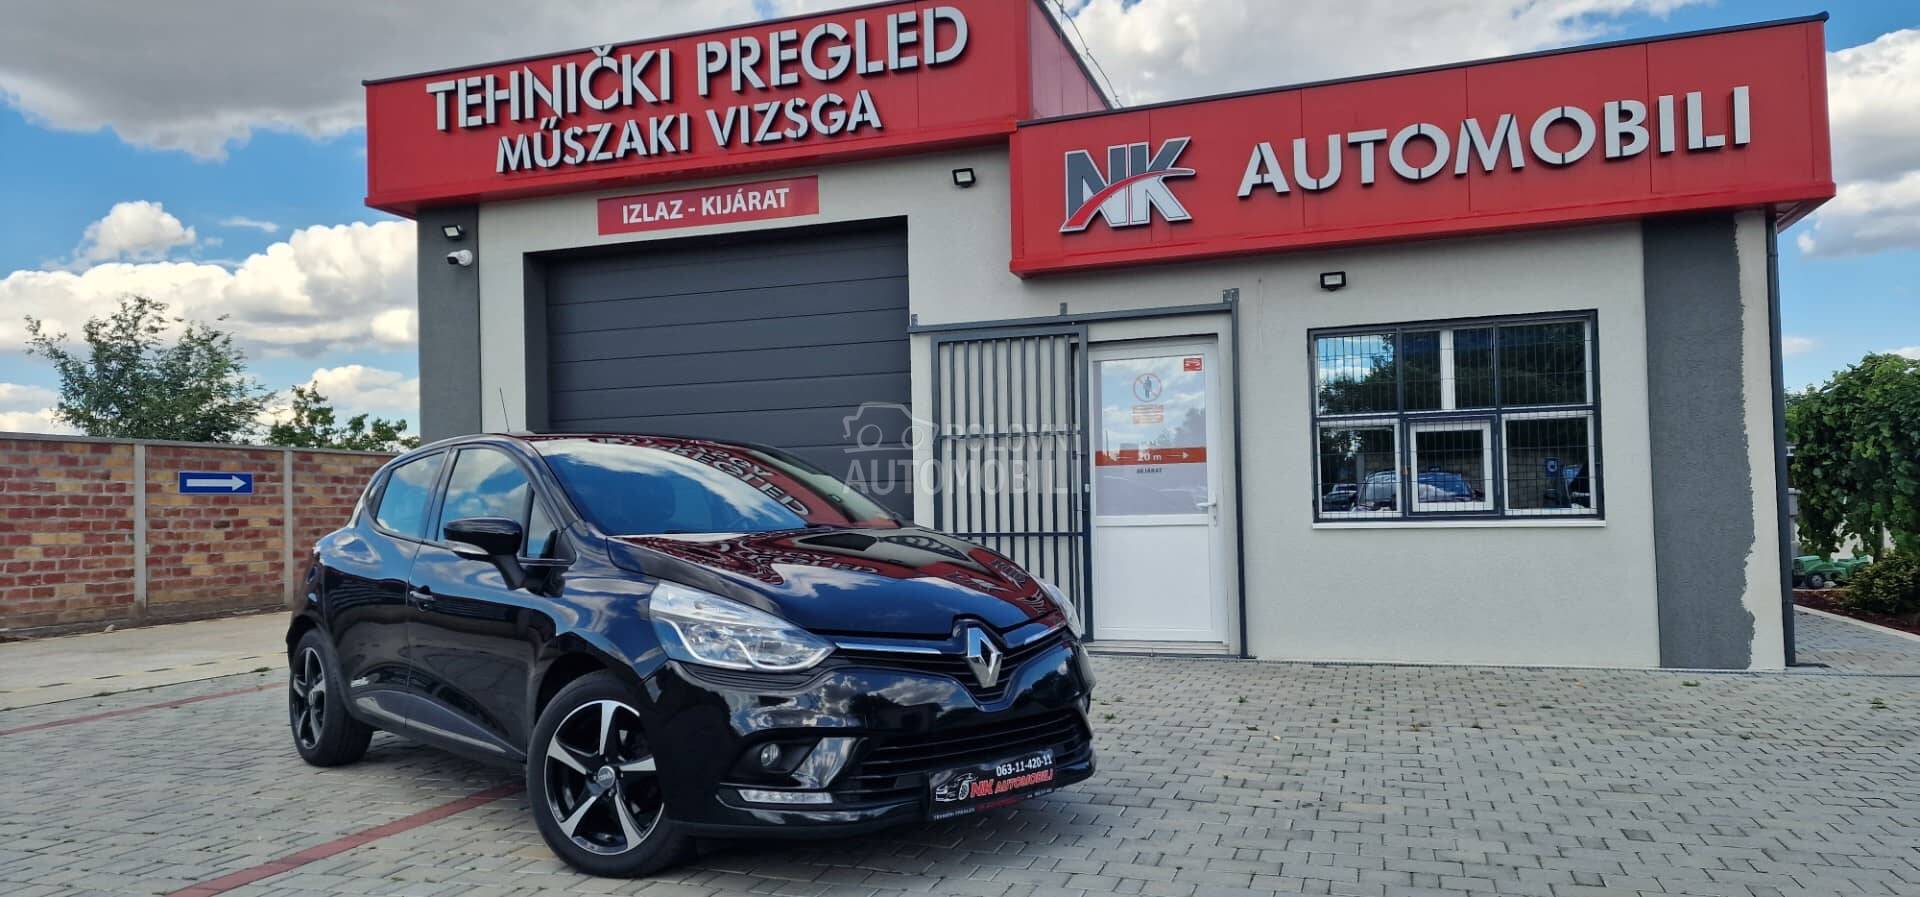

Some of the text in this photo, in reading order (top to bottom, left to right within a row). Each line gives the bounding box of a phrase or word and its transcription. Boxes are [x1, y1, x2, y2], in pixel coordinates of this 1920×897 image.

[426, 6, 968, 131] TEHNIČKI PREGLED
[495, 89, 882, 172] MŰSZAKI VIZSGA
[1059, 86, 1750, 232] NK AUTOMOBILI
[622, 199, 684, 225] IZLAZ
[701, 187, 790, 217] KIJÁRAT
[970, 768, 1053, 798] NK AUTOMOBILI
[996, 754, 1052, 777] 063-11-420-11
